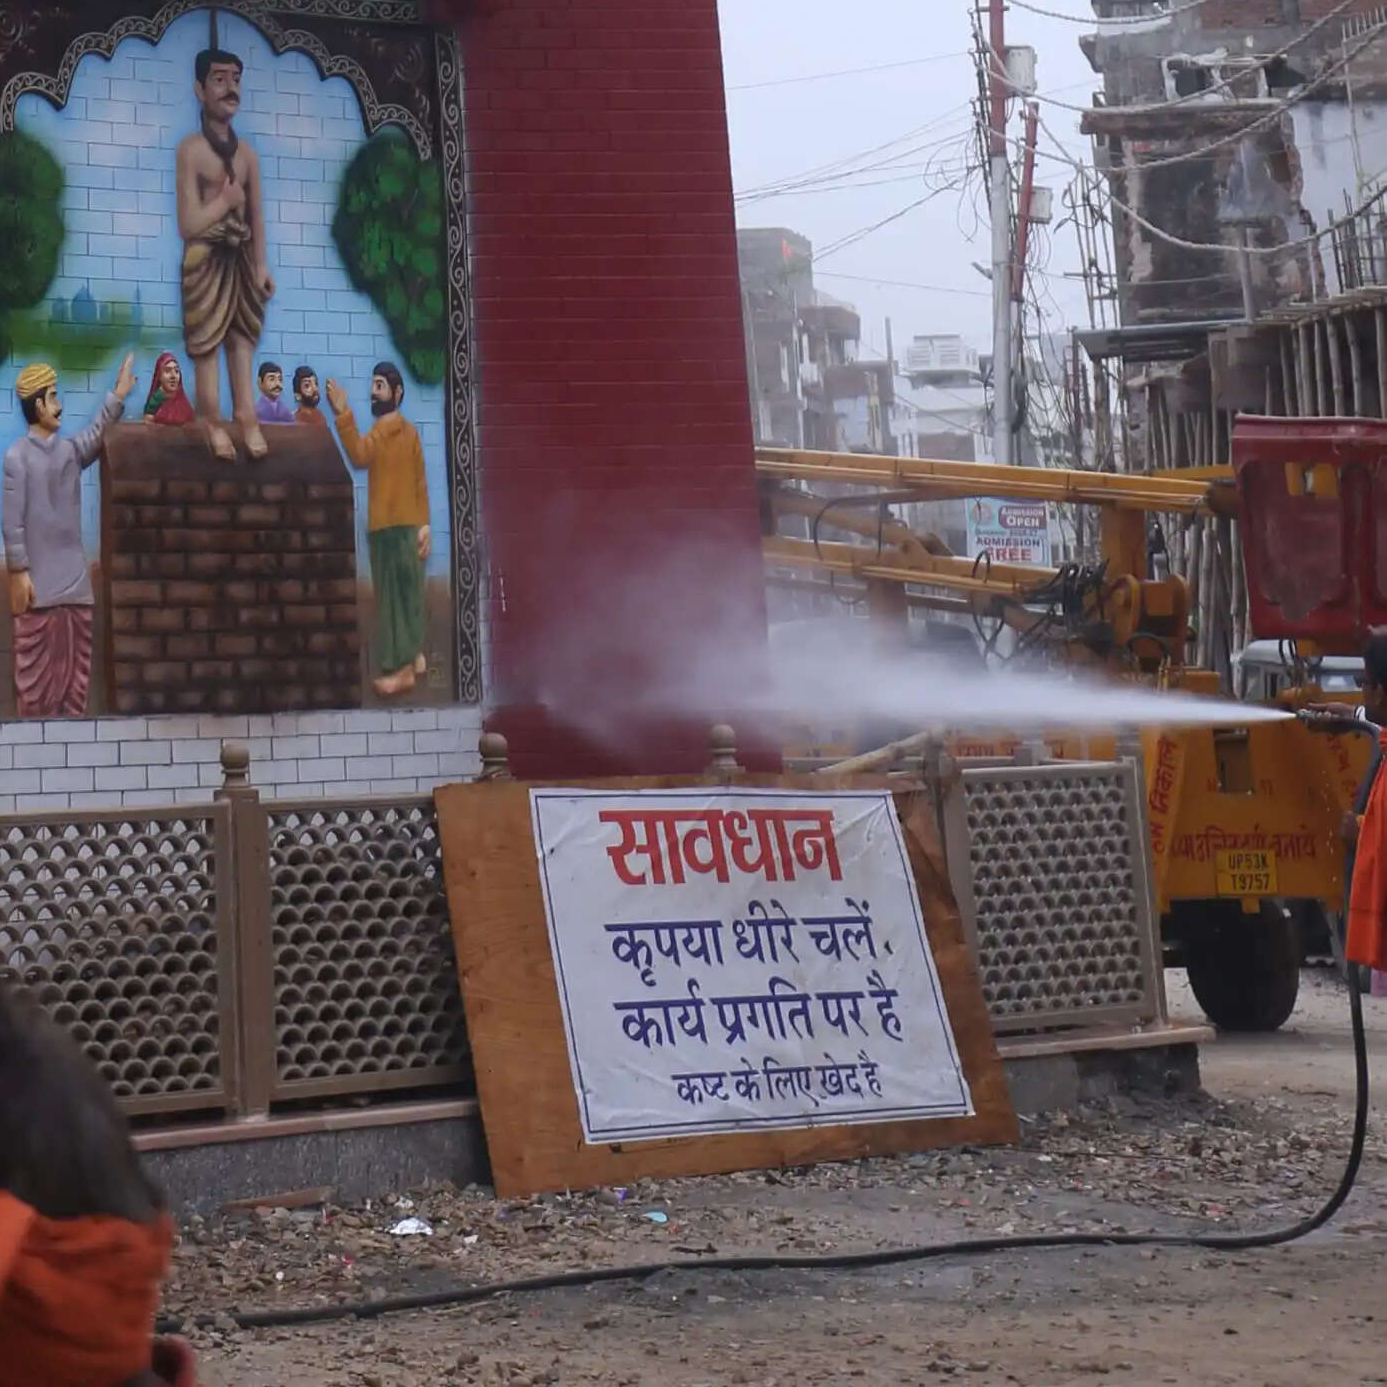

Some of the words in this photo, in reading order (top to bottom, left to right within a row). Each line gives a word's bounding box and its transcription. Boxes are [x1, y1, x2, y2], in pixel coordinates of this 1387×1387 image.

[976, 536, 1041, 547] ADMISSION
[1006, 516, 1040, 527] OPEN
[599, 809, 843, 885] सावधान
[1230, 873, 1271, 891] T9757
[604, 920, 724, 986] कृपया
[732, 898, 800, 965] धीरे
[613, 978, 709, 1048] कार्य
[710, 976, 815, 1045] प्रगति
[815, 991, 869, 1037] पर
[866, 969, 904, 1042] है
[670, 1071, 730, 1105] कष्ट
[730, 1056, 762, 1102] के
[761, 1056, 820, 1107] लिए
[814, 1052, 865, 1100] खेद
[857, 1049, 884, 1099] है
